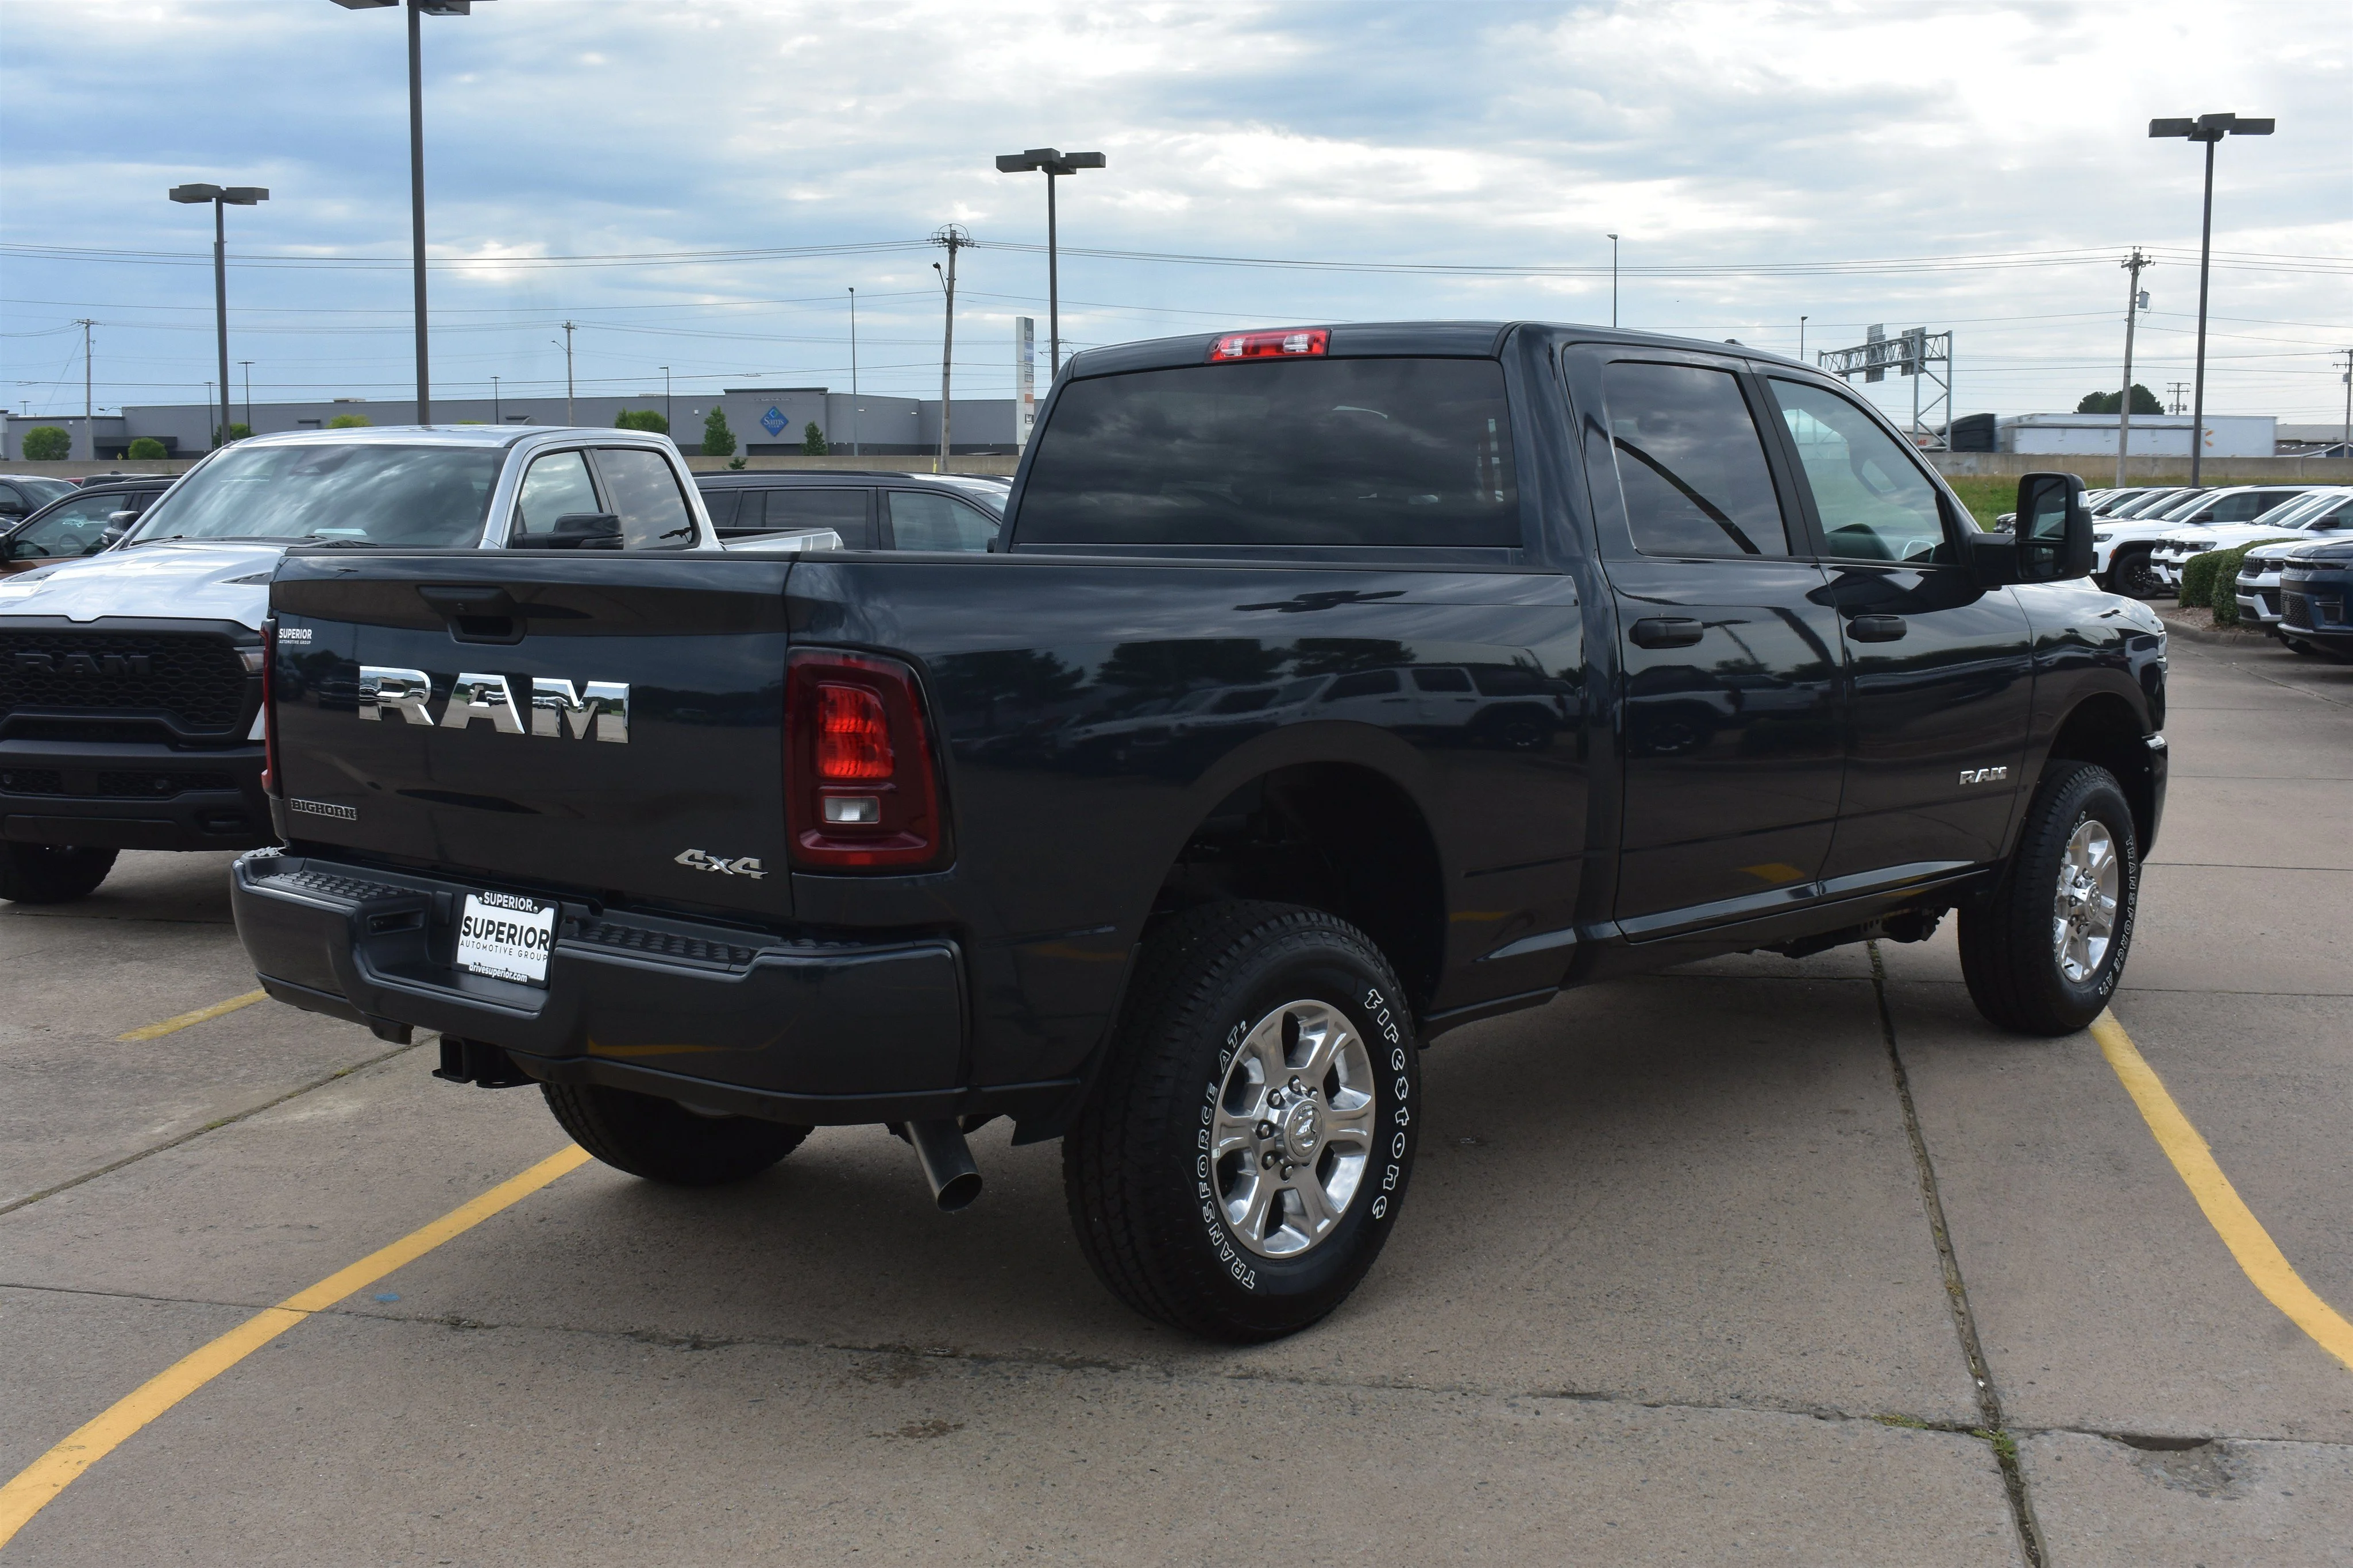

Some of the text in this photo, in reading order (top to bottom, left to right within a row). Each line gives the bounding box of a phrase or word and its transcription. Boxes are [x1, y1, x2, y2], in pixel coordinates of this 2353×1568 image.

[279, 628, 312, 639] SUPERIOR
[15, 652, 151, 675] RAM
[359, 665, 630, 744] RAM
[1959, 766, 2007, 785] RAM
[291, 798, 356, 820] BIGHORN
[484, 891, 533, 912] SUPERIOR
[2113, 835, 2136, 973] TRANSFORCE
[462, 916, 550, 951] SUPERIOR
[460, 940, 548, 962] AUTOMOTIVE GROUP
[469, 962, 528, 982] drivesuperior.com
[1364, 988, 1410, 1219] Firestone
[1197, 1082, 1255, 1289] TRANSFORCE
